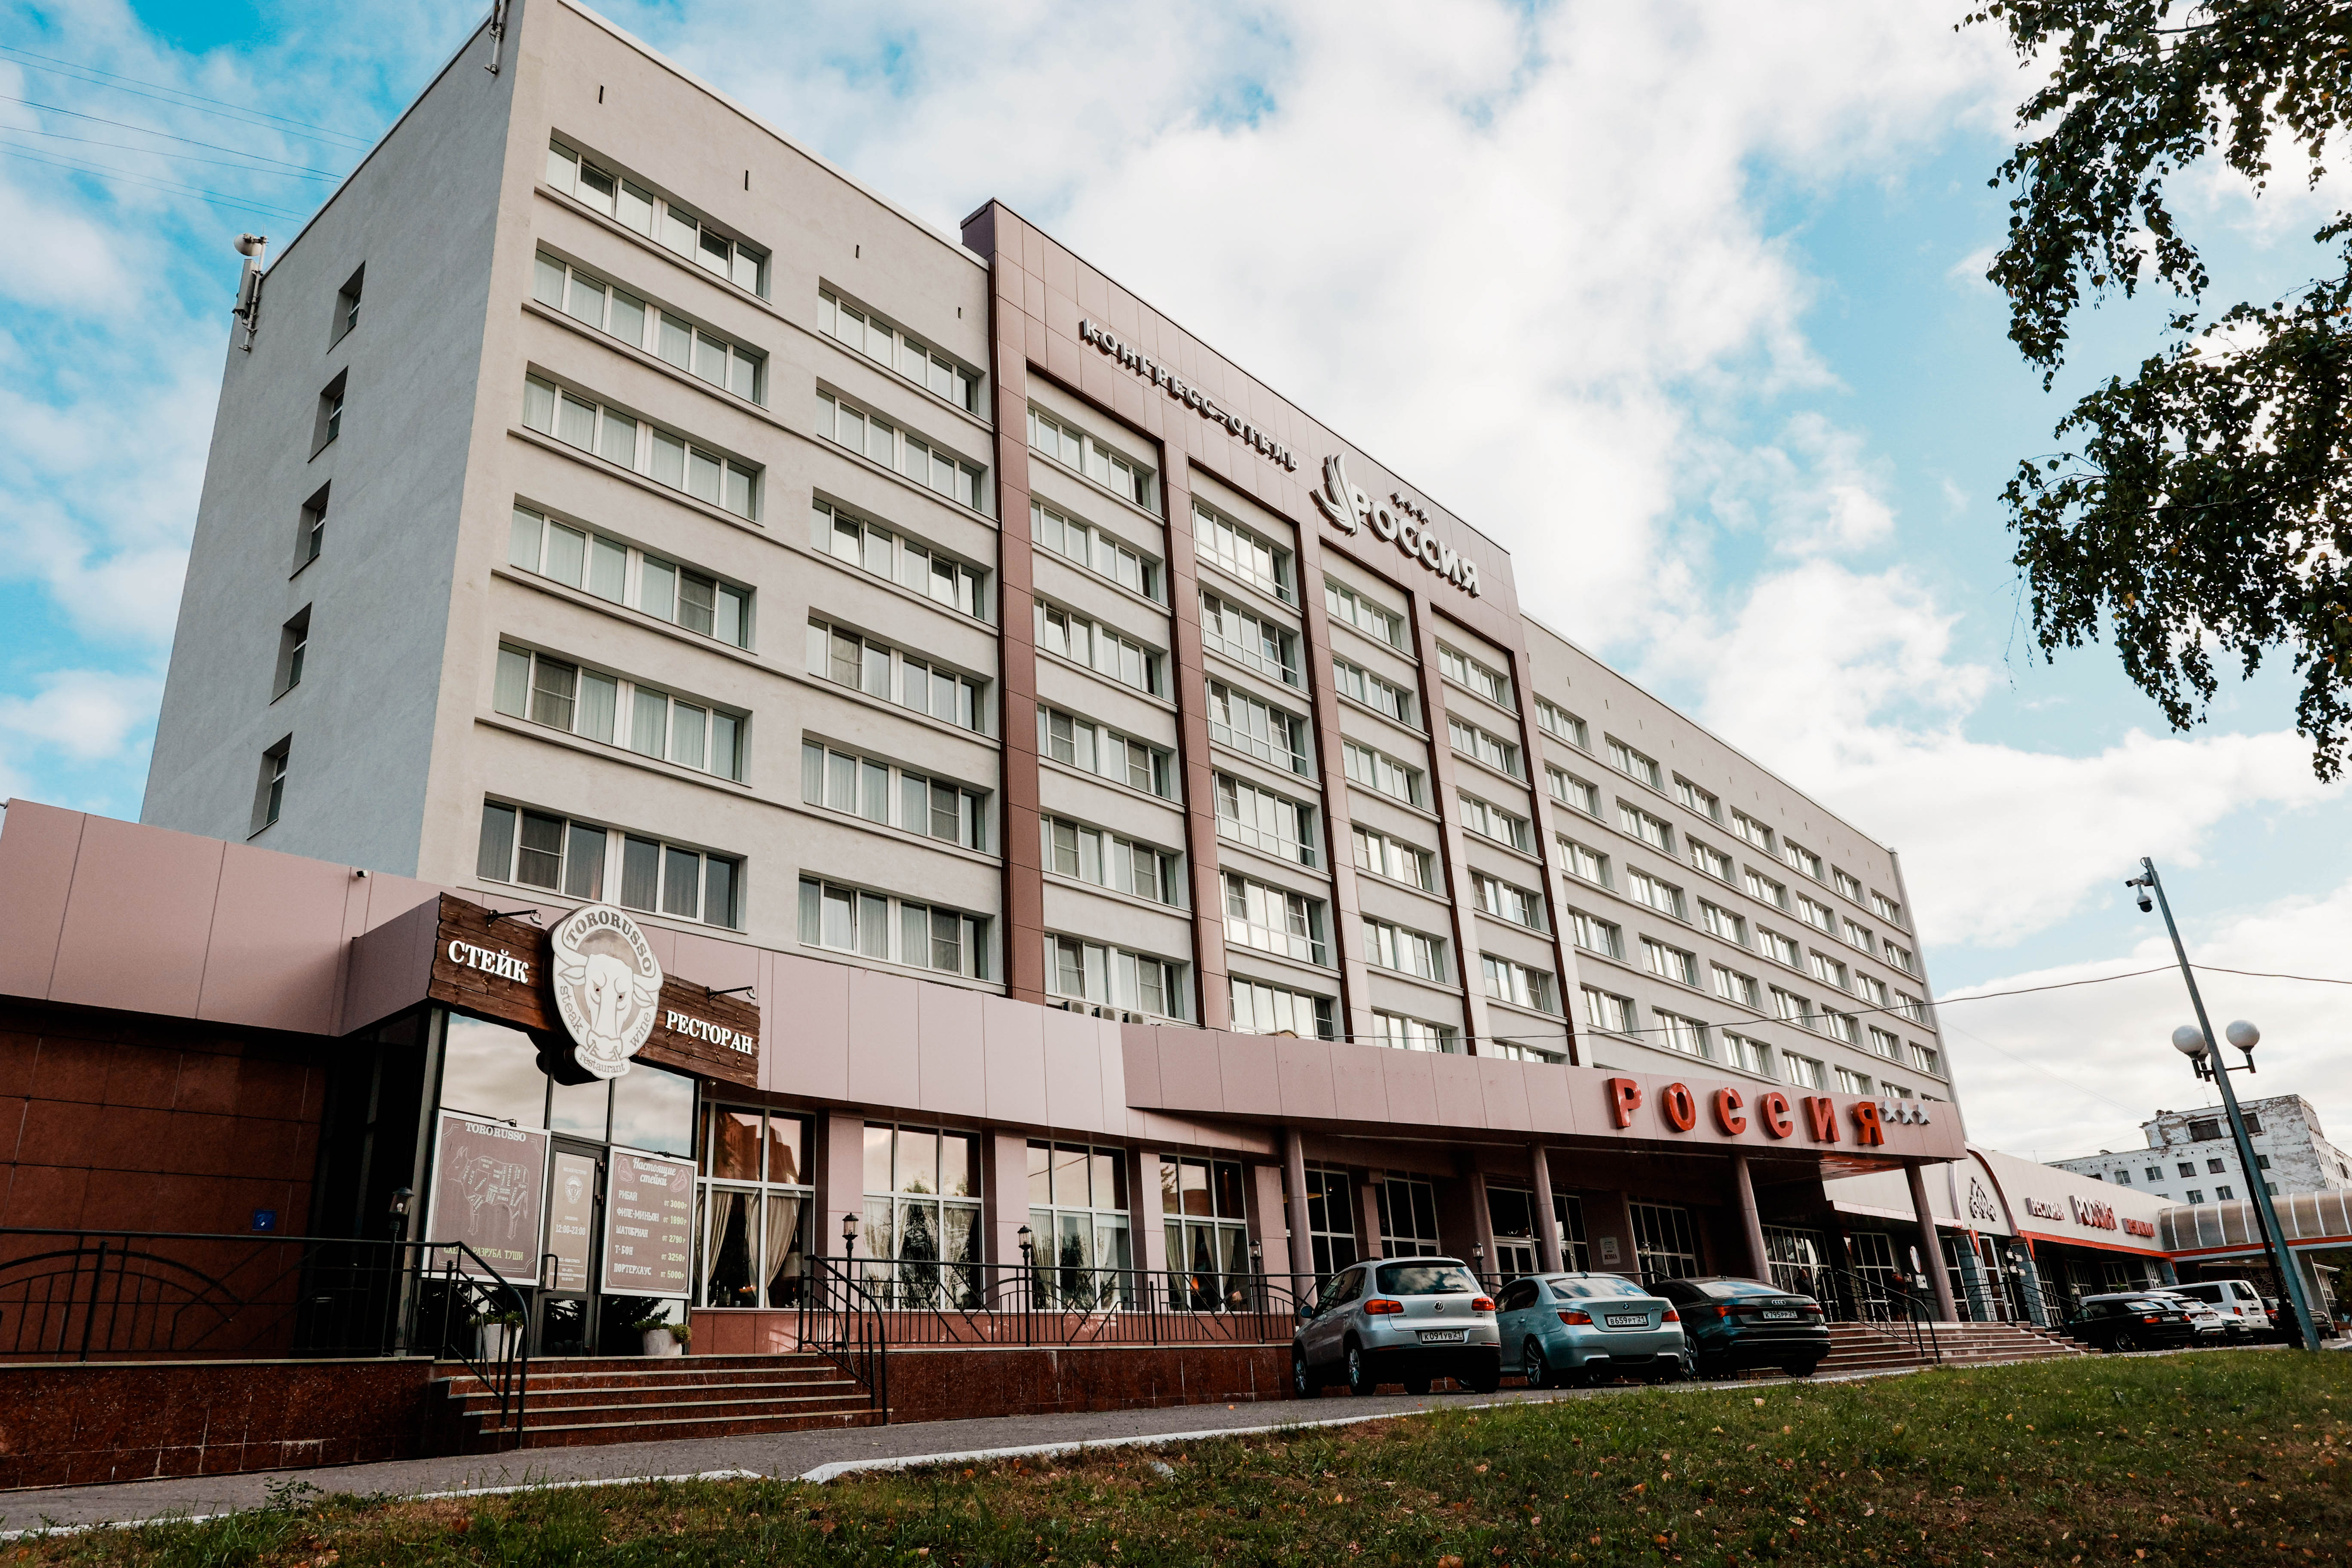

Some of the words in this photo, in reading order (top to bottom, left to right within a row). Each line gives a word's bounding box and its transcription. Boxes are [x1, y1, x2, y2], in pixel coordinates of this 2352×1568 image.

[1082, 317, 1300, 471] КОНГРЕСС-ОТЕЛЬ
[1344, 481, 1481, 597] РОССИЯ
[566, 911, 652, 972] TORORUSSO
[448, 940, 529, 984] СТЕЙК
[560, 986, 584, 1035] steak
[629, 1012, 651, 1047] wine
[665, 1010, 753, 1055] РЕСТОРАН
[579, 1053, 625, 1073] restaurant
[1608, 1077, 1885, 1146] РОССИЯ
[465, 1122, 527, 1142] TORORUSSO
[632, 1157, 677, 1177] Настоящие
[640, 1173, 668, 1186] стейки
[618, 1189, 638, 1201] РИБАЙ
[2026, 1197, 2065, 1220] РЕСТОРАН
[556, 1224, 585, 1236] 12:00-23:00
[473, 1246, 502, 1259] РАЗРУБА
[505, 1250, 524, 1261] ТУШИ
